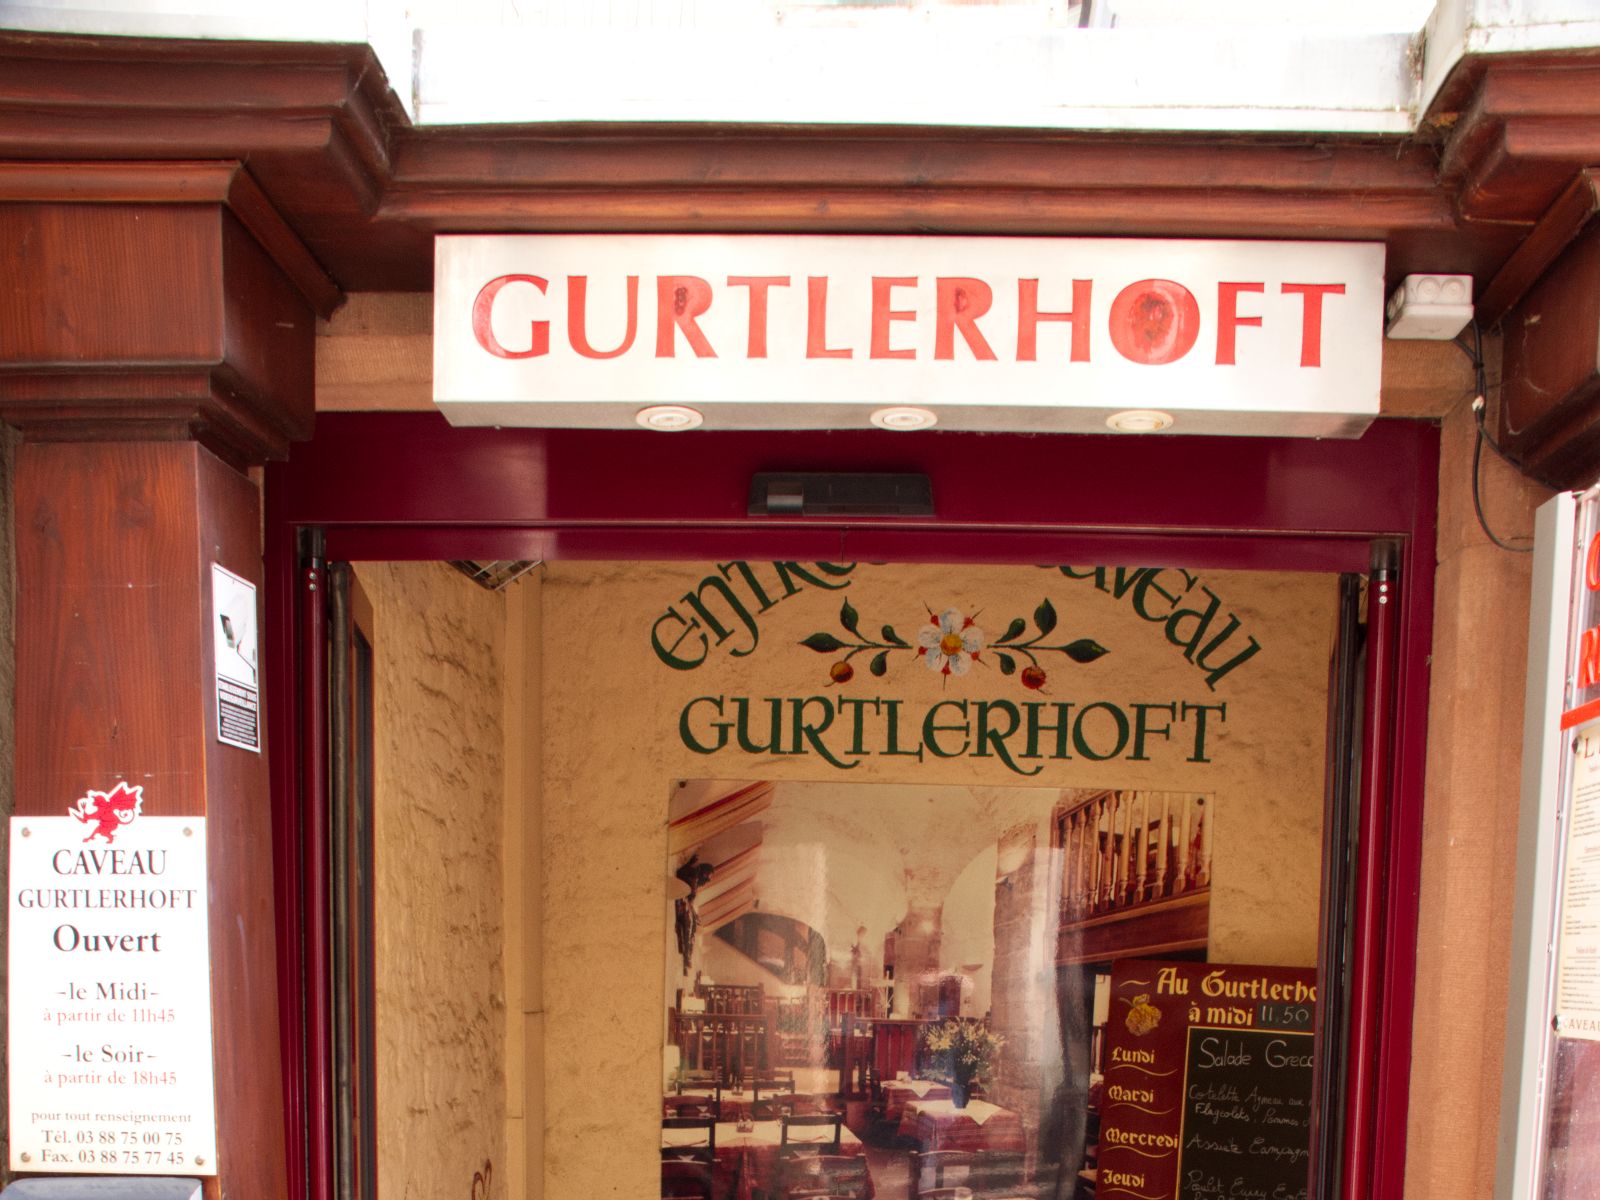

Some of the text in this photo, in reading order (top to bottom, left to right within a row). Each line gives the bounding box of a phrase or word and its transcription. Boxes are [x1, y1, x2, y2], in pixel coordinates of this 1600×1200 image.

[471, 273, 1346, 367] GURTLERHOFT
[678, 693, 1227, 776] GURTLERHOFT
[52, 849, 167, 875] CAVEAU
[18, 889, 197, 909] GURTLERHOFT
[53, 924, 162, 952] Ouvert
[1157, 967, 1189, 995] Au
[43, 1008, 175, 1025] à partir de 11h45
[1207, 1006, 1253, 1026] midi
[1112, 1047, 1155, 1064] Lundi
[1198, 1037, 1252, 1068] Salade
[44, 1070, 177, 1088] à partir de 18h45
[1108, 1085, 1154, 1102] Mardi
[31, 1111, 191, 1124] pour tout renseignement
[41, 1130, 182, 1145] Tél. 03 88 75 00 75
[1106, 1128, 1178, 1149] Mercredi
[41, 1149, 184, 1165] Fax. 03 88 75 77 45
[1103, 1169, 1145, 1188] Jeudi
